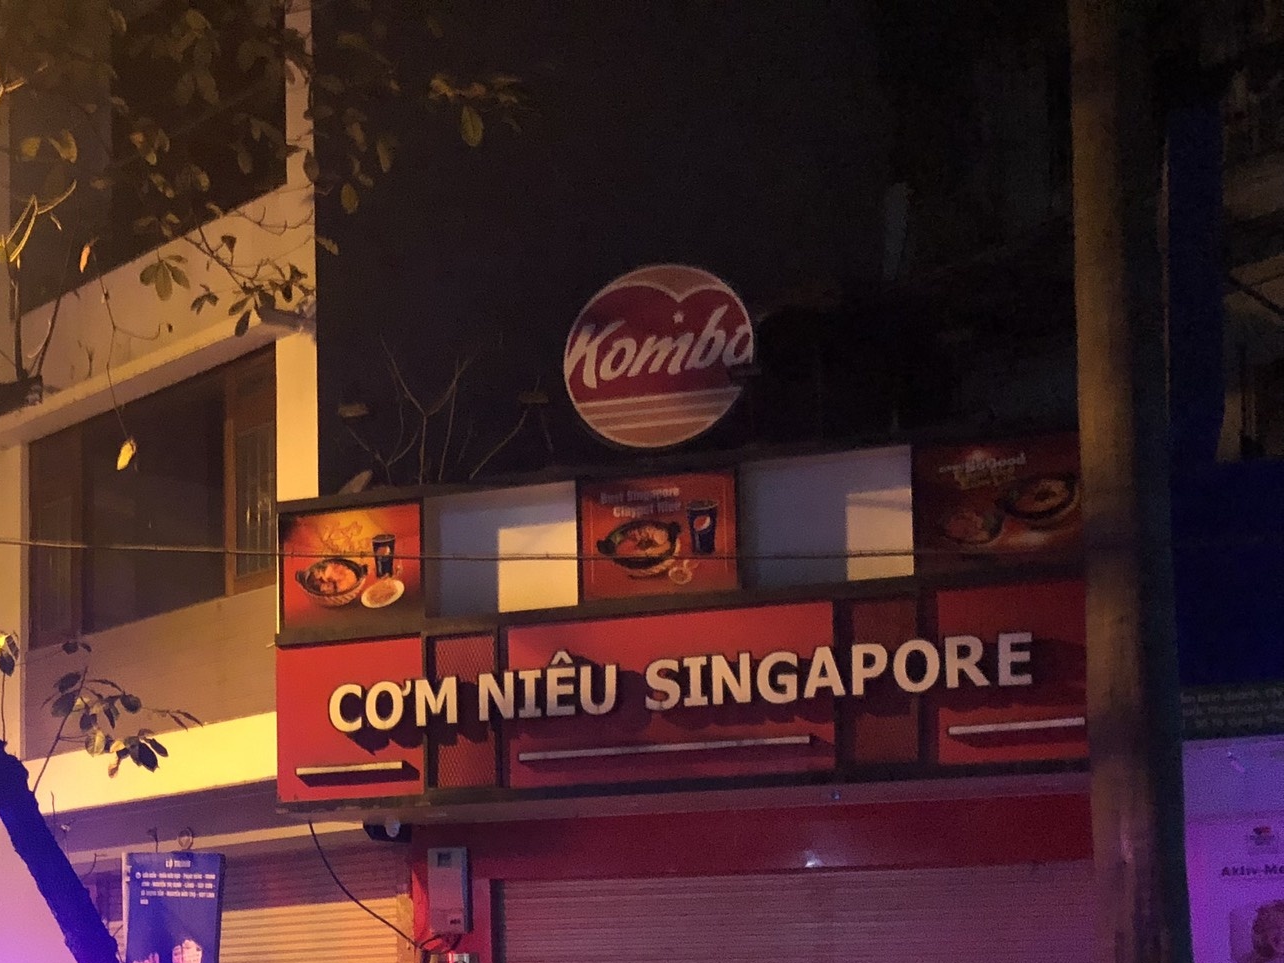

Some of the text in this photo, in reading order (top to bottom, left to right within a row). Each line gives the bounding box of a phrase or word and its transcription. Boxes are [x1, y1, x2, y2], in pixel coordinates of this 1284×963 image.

[328, 631, 1034, 734] CƠM NIÊU SINGAPORE
